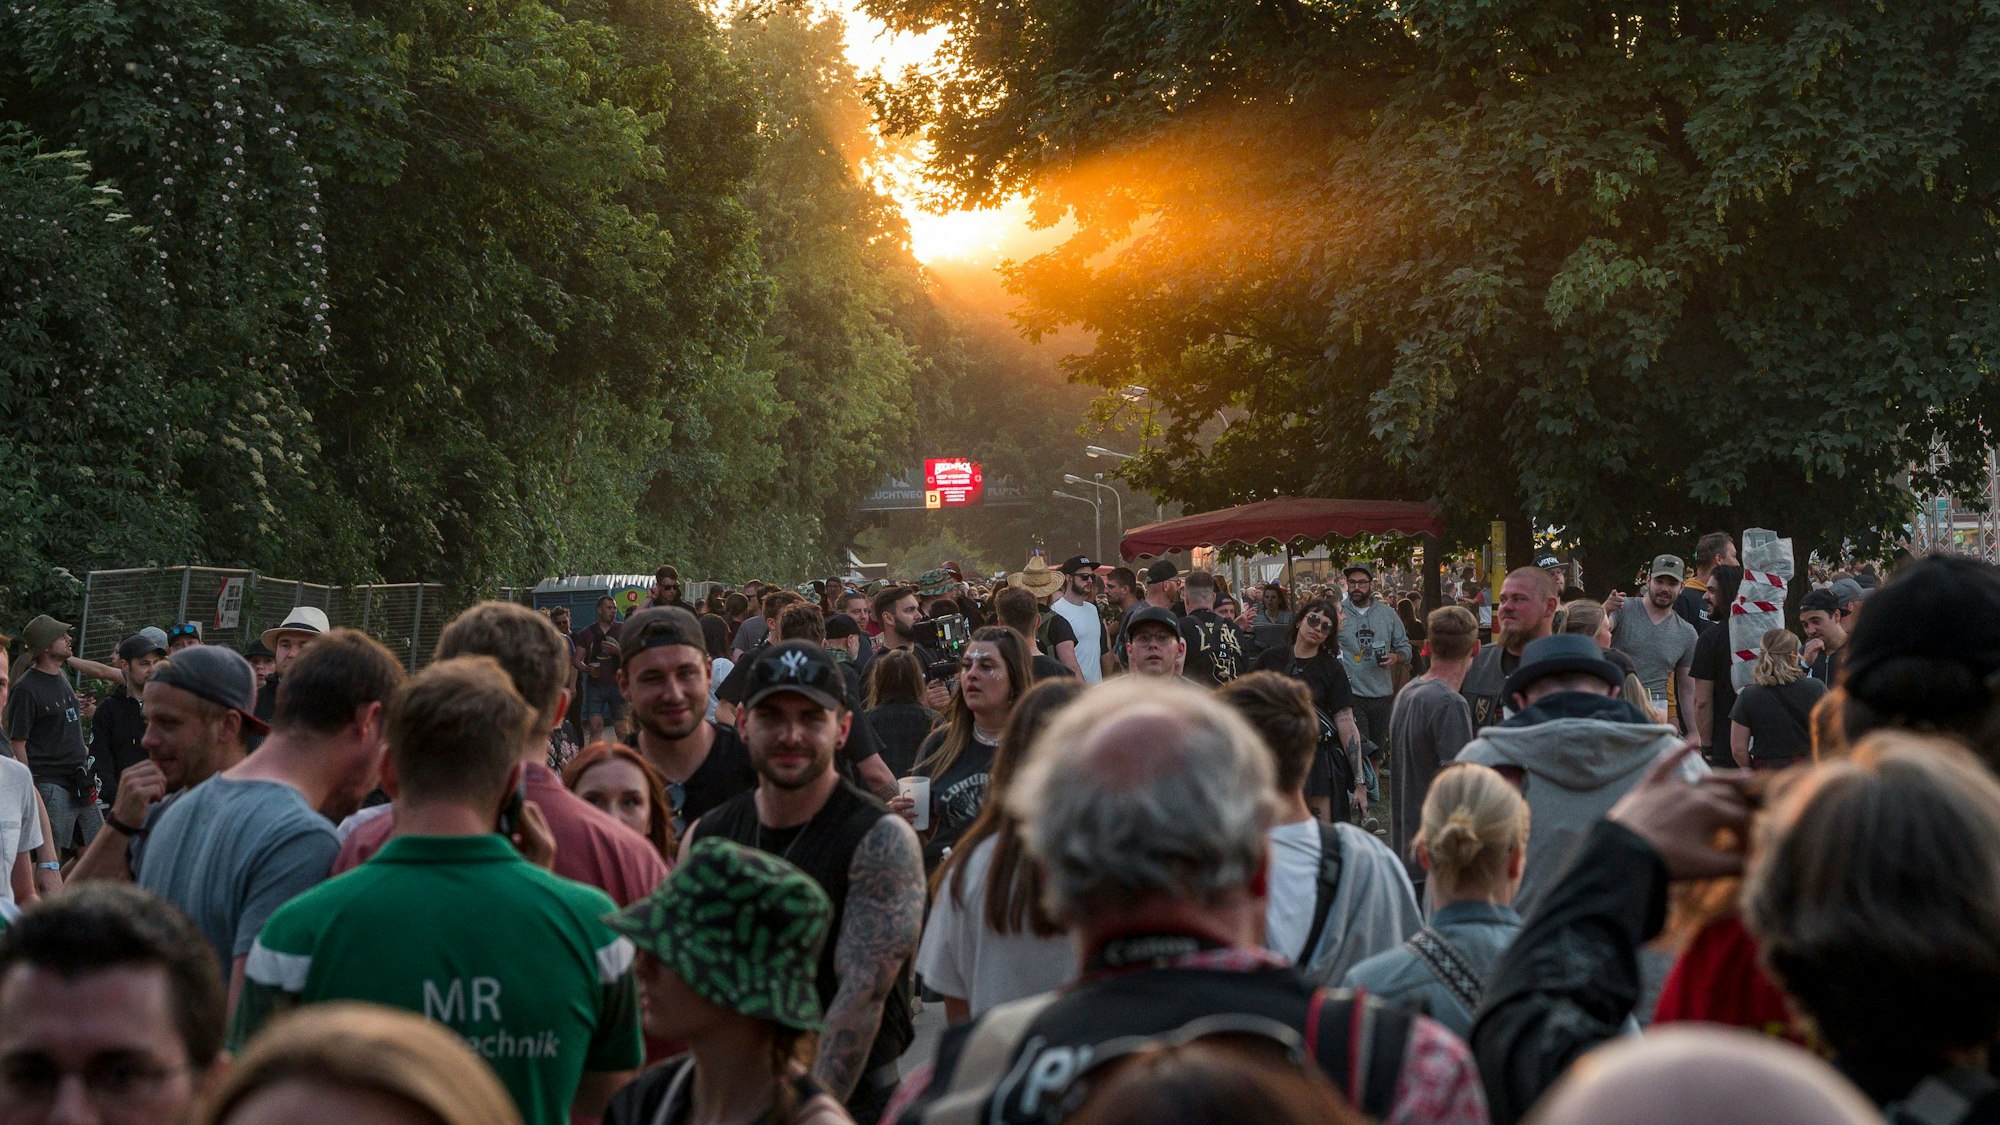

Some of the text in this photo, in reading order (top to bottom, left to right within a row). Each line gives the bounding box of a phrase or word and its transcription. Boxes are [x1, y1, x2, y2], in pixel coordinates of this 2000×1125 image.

[864, 490, 923, 500] UCHTWEG
[930, 494, 937, 502] D
[422, 976, 502, 1023] MR
[464, 1027, 561, 1058] echnik
